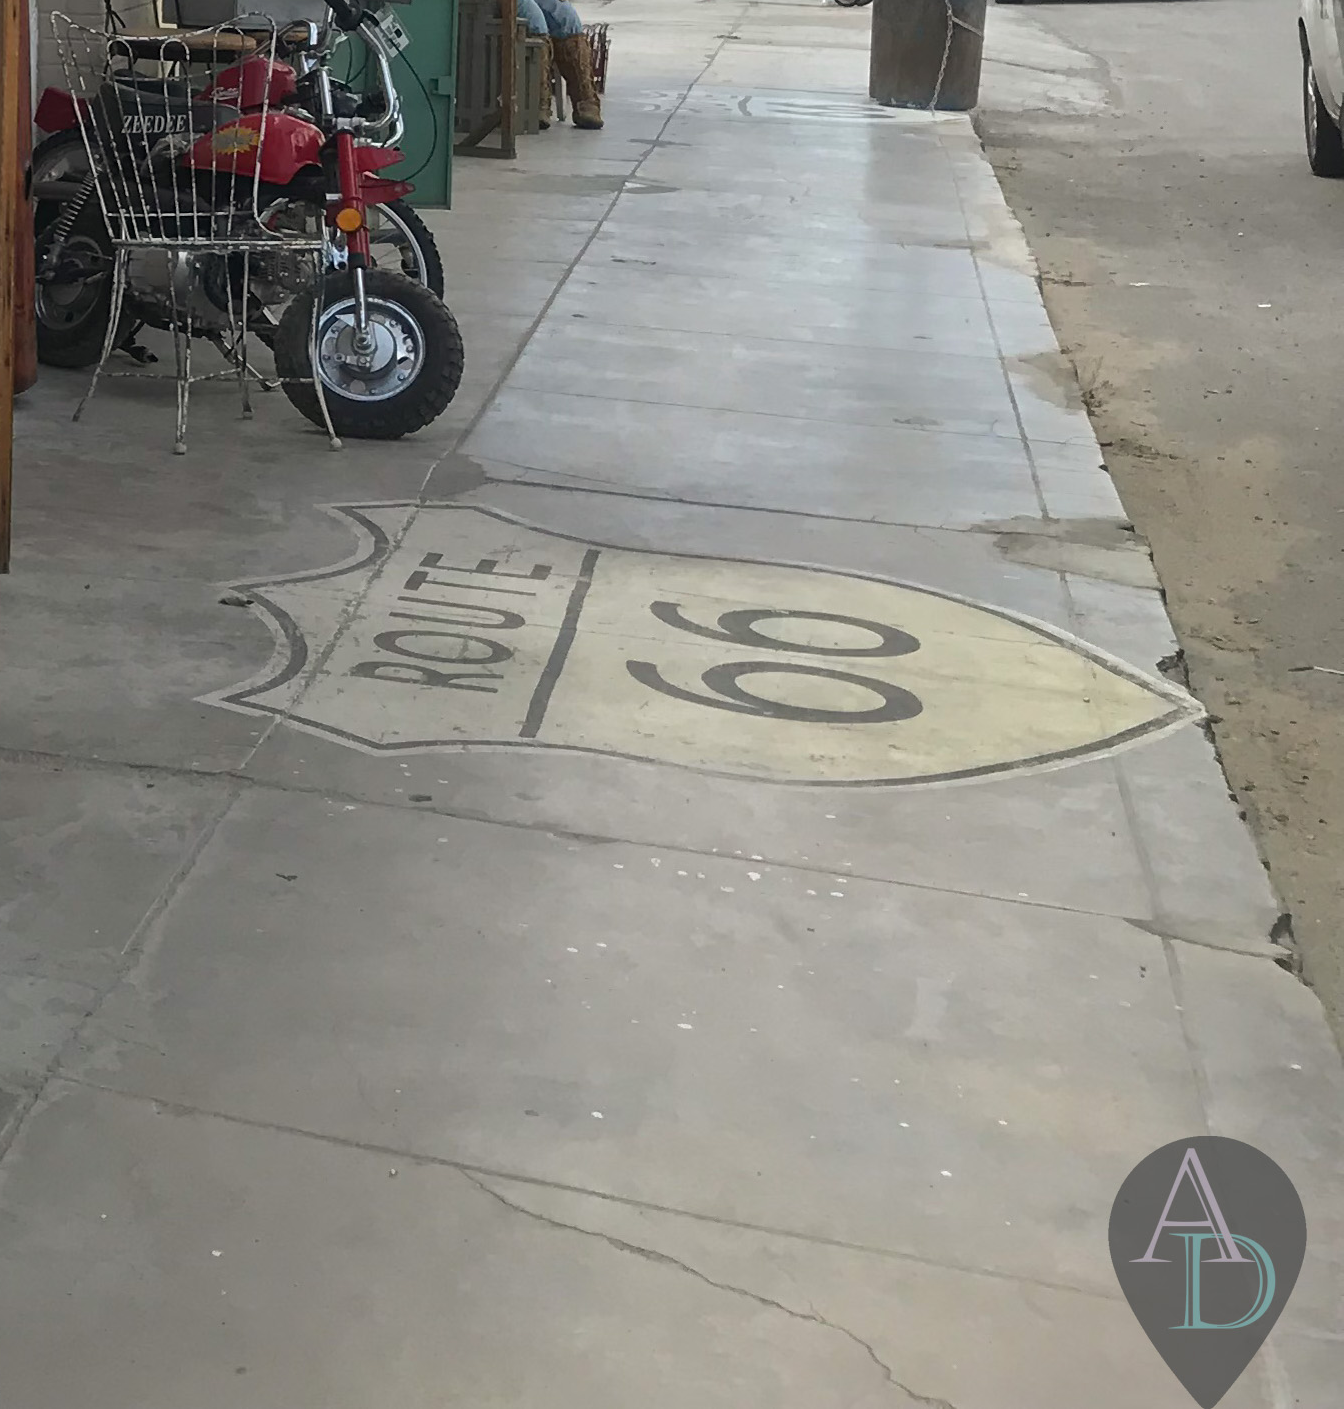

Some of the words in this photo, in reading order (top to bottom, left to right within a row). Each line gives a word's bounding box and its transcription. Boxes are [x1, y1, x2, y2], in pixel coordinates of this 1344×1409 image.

[121, 114, 187, 134] ZEEDEE
[350, 551, 552, 693] ROUTE
[626, 600, 923, 724] 66
